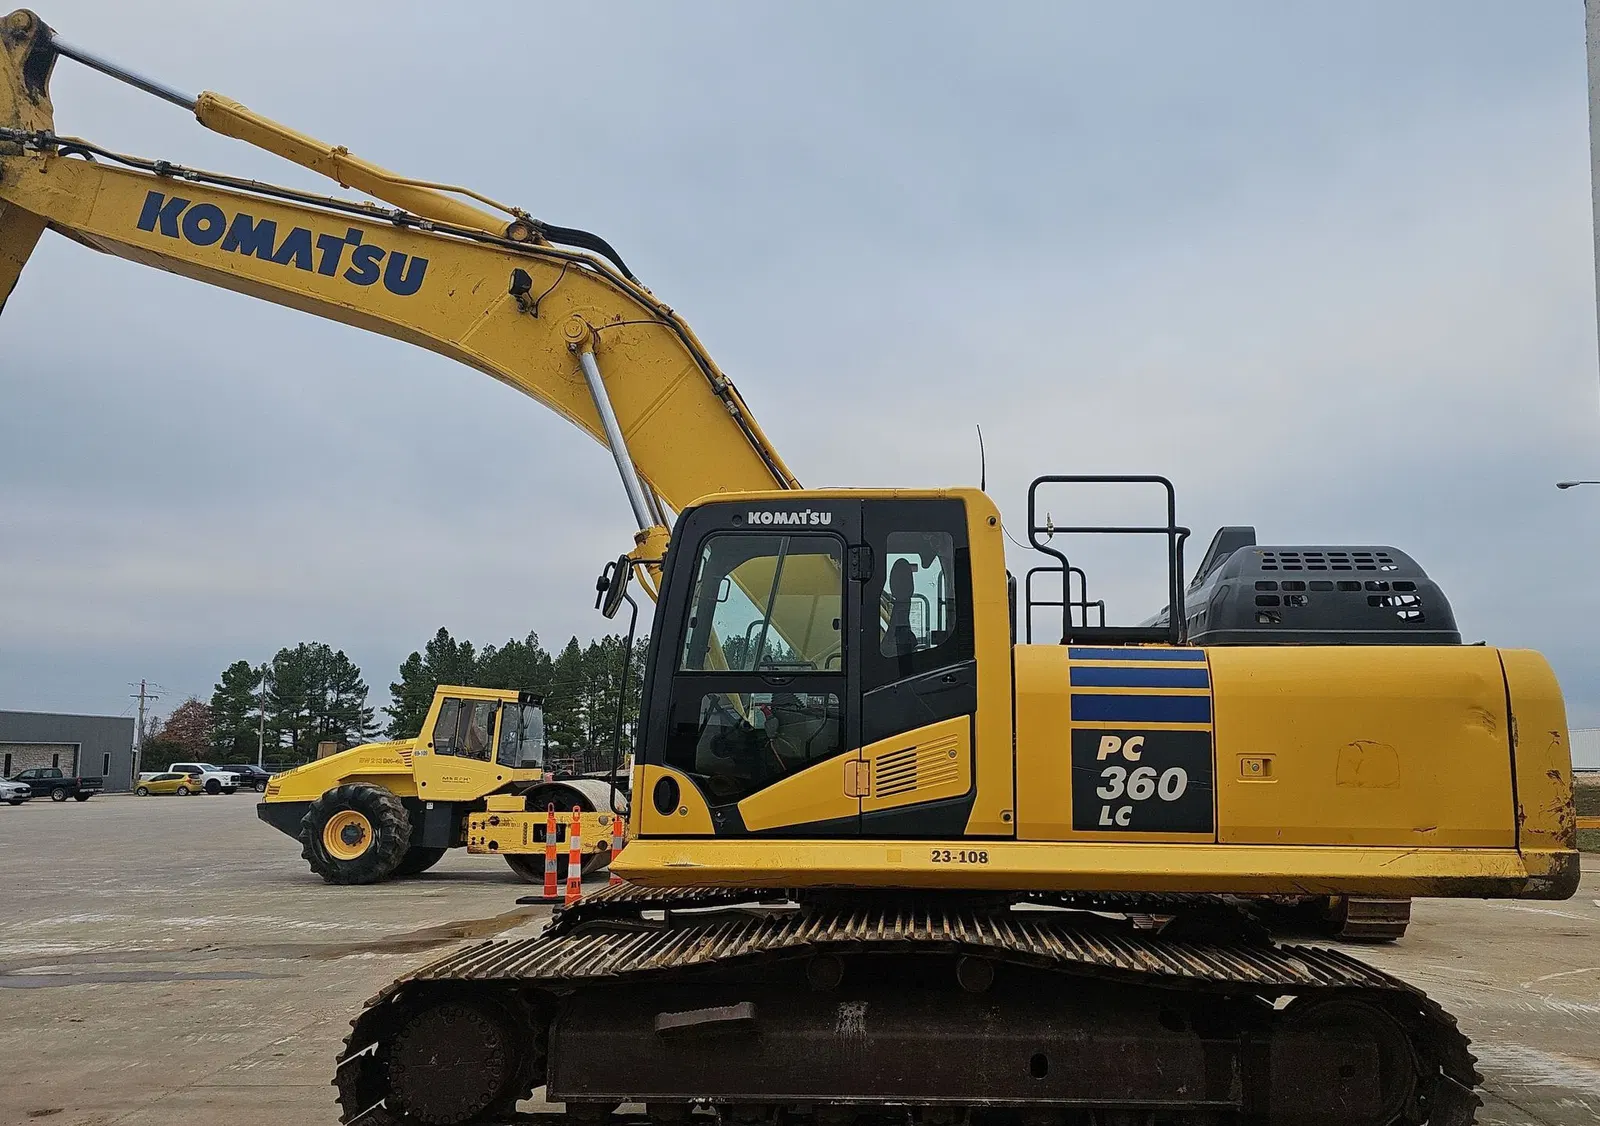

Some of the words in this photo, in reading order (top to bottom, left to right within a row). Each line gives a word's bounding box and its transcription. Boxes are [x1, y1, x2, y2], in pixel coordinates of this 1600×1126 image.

[136, 190, 429, 296] KOMATSU
[748, 509, 832, 525] KOMATSU
[1096, 735, 1145, 761] PC
[1096, 766, 1188, 801] 360
[1099, 805, 1133, 826] LC
[931, 850, 988, 863] 23-108
